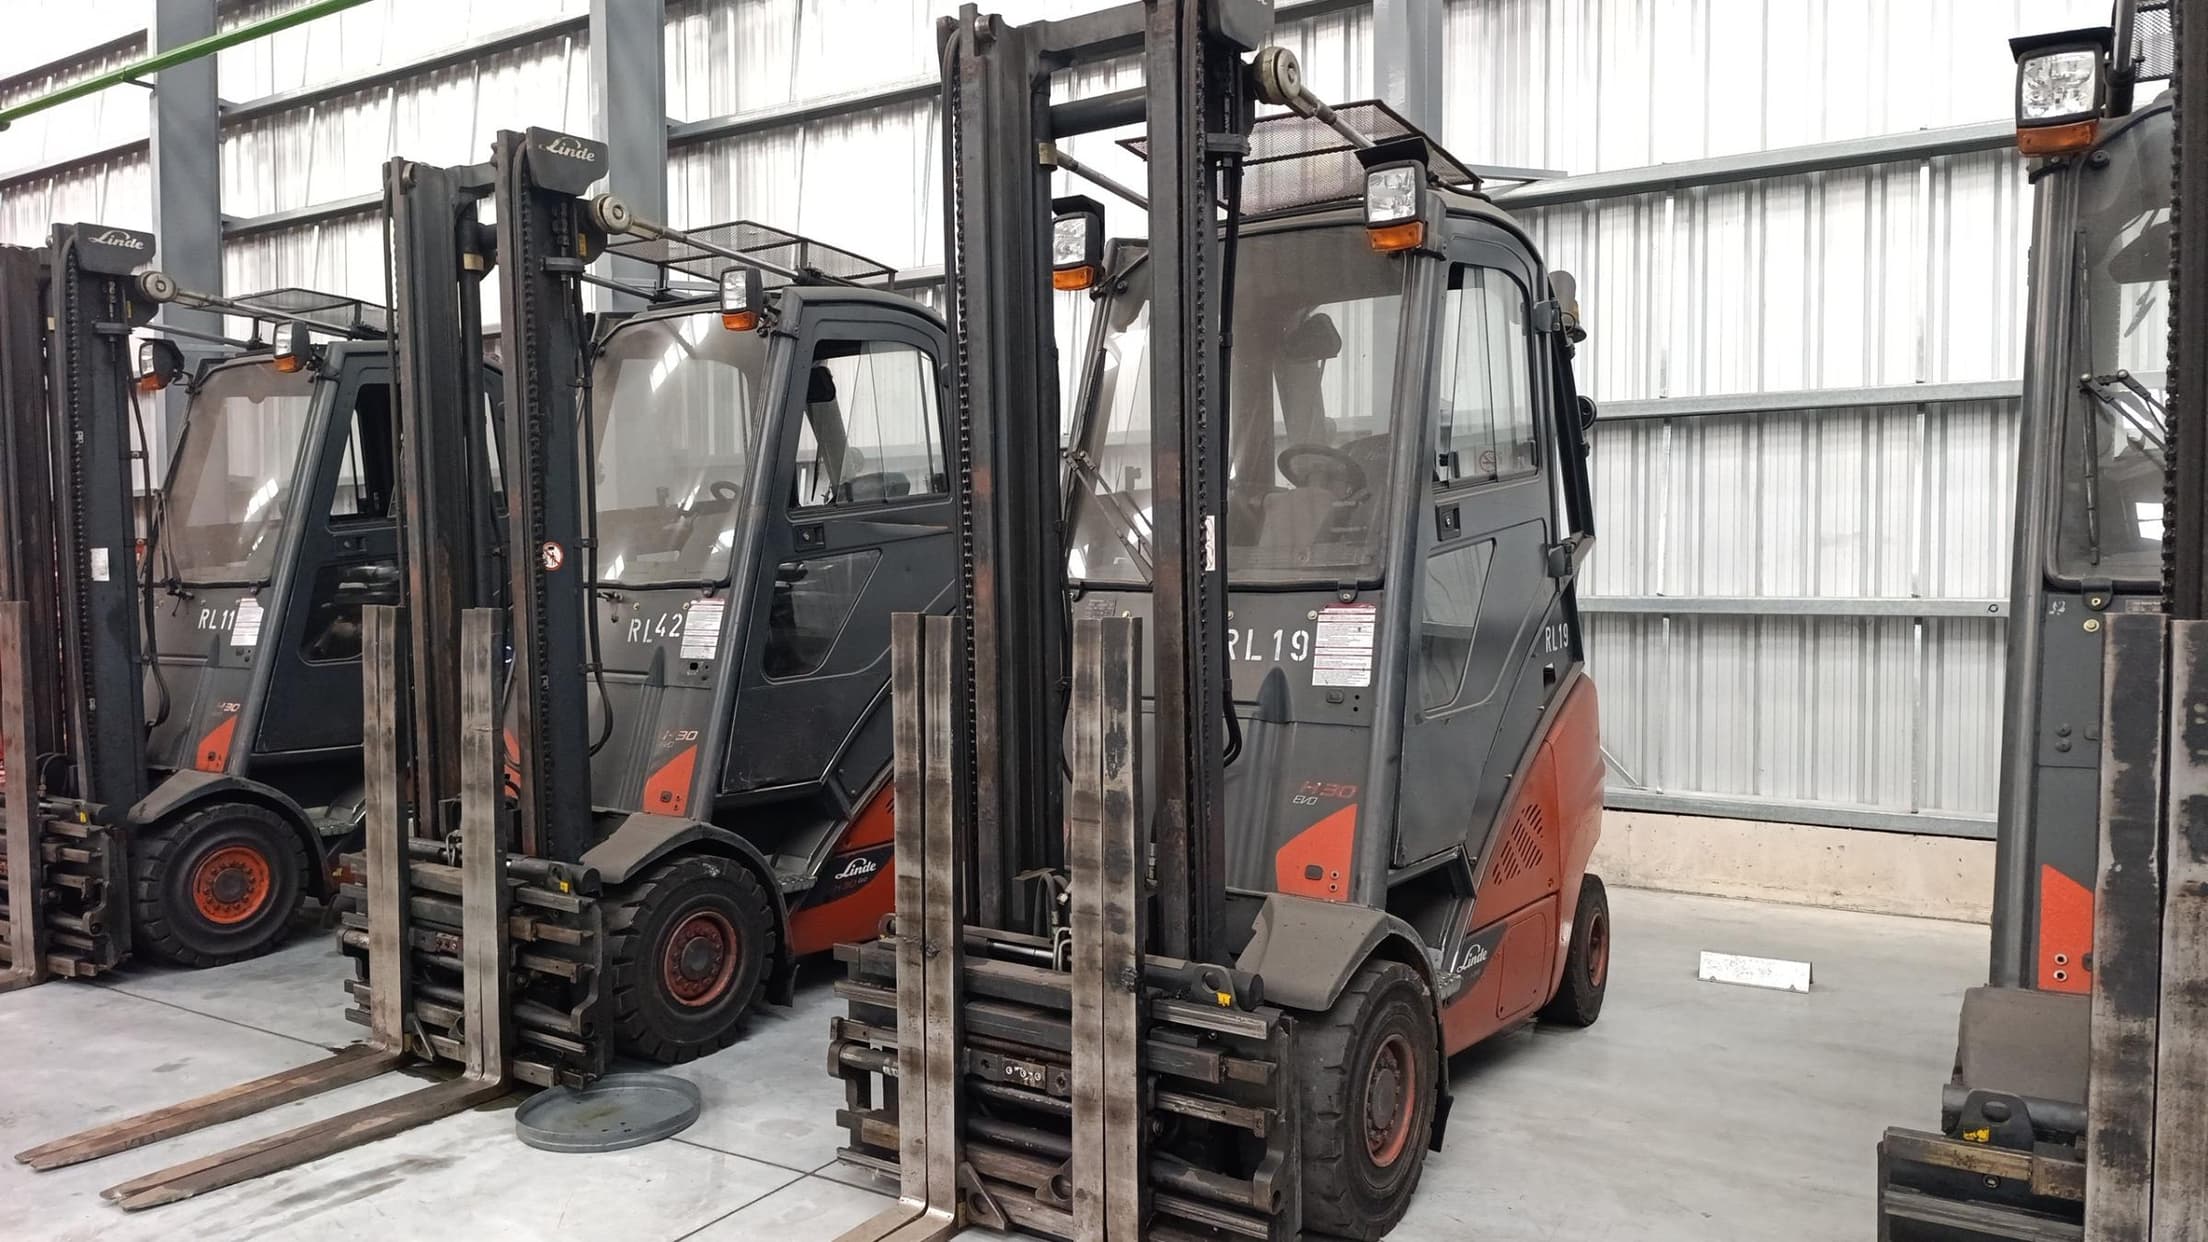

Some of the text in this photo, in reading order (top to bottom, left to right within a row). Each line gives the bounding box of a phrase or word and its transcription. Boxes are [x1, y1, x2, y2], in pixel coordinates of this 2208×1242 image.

[538, 136, 596, 162] Linde
[87, 230, 145, 250] Linde
[198, 608, 236, 631] RL11
[1292, 794, 1319, 806] EVO
[834, 857, 877, 880] Linde
[1456, 943, 1488, 974] Linde
